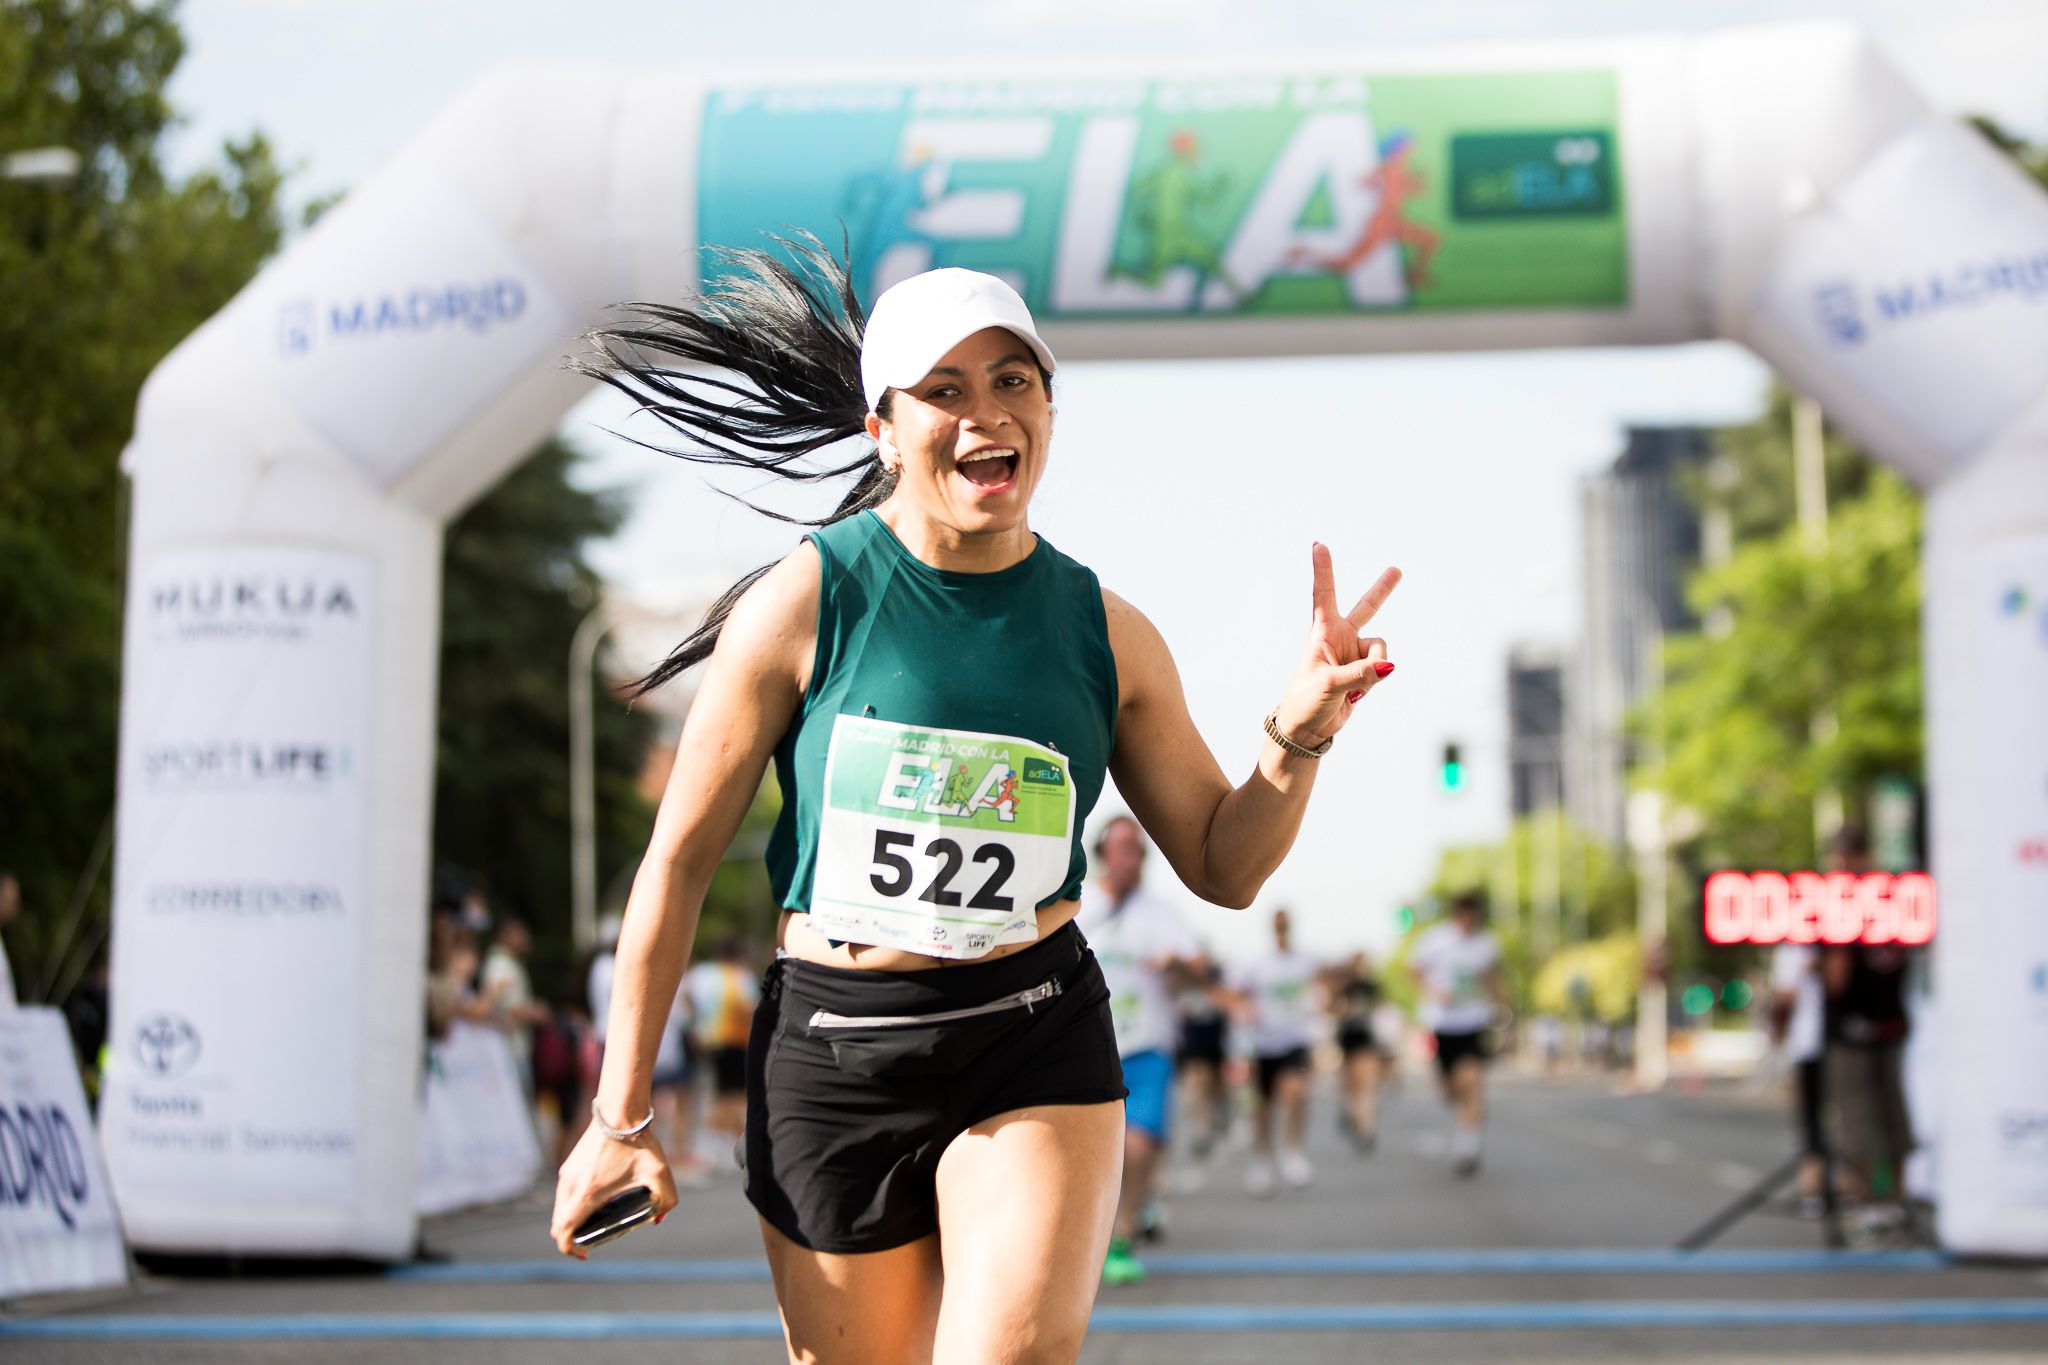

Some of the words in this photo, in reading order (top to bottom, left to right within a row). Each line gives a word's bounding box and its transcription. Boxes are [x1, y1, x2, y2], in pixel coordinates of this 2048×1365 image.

[868, 111, 1406, 312] ELA
[329, 277, 528, 335] MADRID
[895, 738, 955, 755] MADRID
[959, 744, 988, 759] CON
[991, 748, 1010, 761] LA
[1028, 768, 1060, 780] adELA
[878, 751, 1014, 822] ELA
[870, 829, 1014, 911] 522
